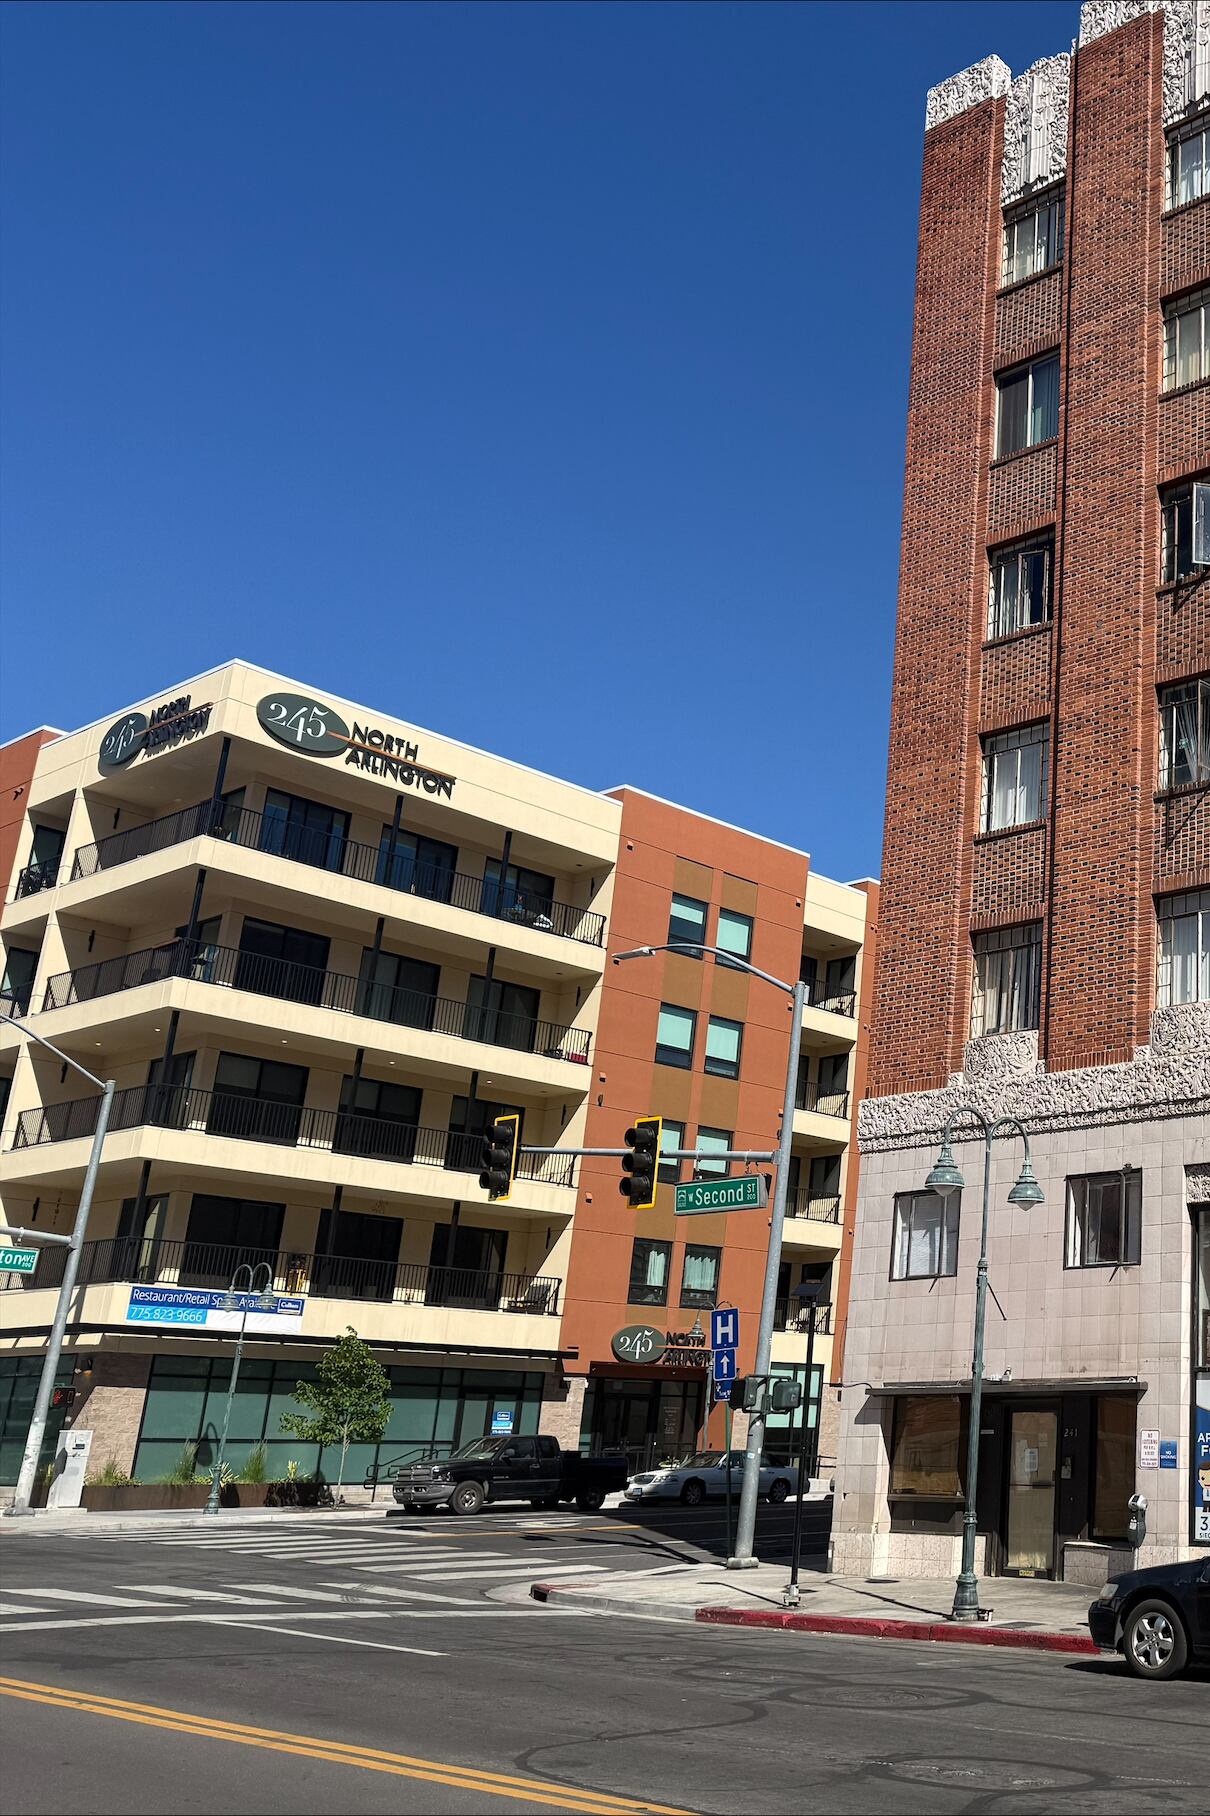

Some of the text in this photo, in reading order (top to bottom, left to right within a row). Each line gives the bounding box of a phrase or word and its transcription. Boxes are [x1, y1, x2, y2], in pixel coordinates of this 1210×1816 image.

[267, 702, 329, 742] 245
[103, 719, 136, 759] 245
[352, 721, 419, 762] NORTH
[345, 747, 457, 800] ARLINGTON
[695, 1184, 744, 1206] Second
[746, 1183, 756, 1194] ST
[21, 1254, 36, 1263] AVE
[133, 1288, 210, 1305] Restaurant/Retail
[131, 1307, 203, 1322] 775 823 9666
[716, 1314, 734, 1345] H
[619, 1330, 654, 1360] 245
